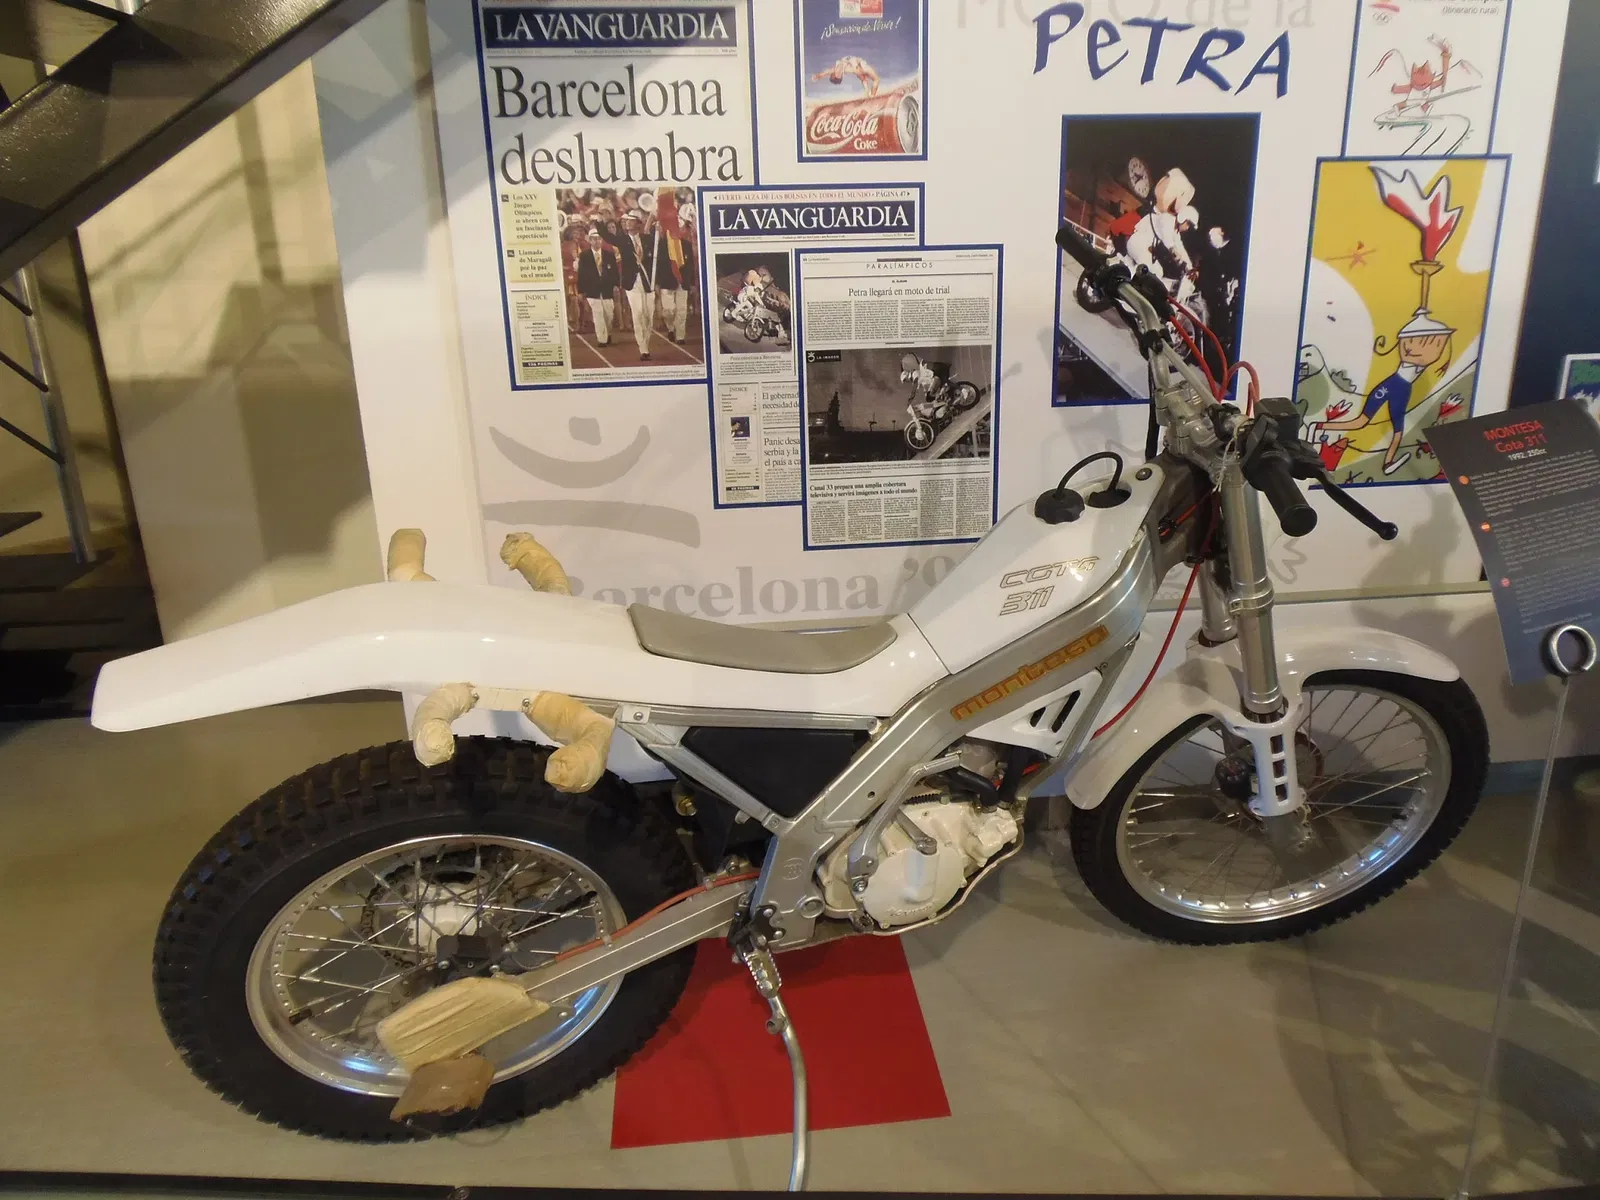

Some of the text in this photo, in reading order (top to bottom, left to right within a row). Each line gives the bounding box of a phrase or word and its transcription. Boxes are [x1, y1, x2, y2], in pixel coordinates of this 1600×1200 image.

[494, 11, 730, 42] LA VANGUARDIA
[1033, 1, 1290, 99] PETRA
[490, 63, 728, 119] Barcelona
[854, 137, 878, 150] Coke
[500, 130, 744, 185] deslumbra
[718, 204, 909, 230] LA VANGUARDIA
[848, 288, 868, 297] Petra
[869, 287, 892, 298] llegará
[925, 287, 934, 295] de
[935, 286, 950, 294] trial
[762, 392, 769, 400] El
[762, 401, 793, 409] necesidad
[1483, 420, 1544, 440] MONTESA
[764, 437, 801, 446] Panic desa
[1495, 433, 1548, 452] Cota 311
[763, 447, 799, 457] serbia y la
[772, 459, 786, 467] país
[834, 484, 854, 492] prepara
[865, 482, 882, 490] amplia
[999, 555, 1102, 588] COTA
[566, 566, 882, 618] arcelona
[999, 585, 1055, 617] 311
[951, 624, 1110, 721] montesa
